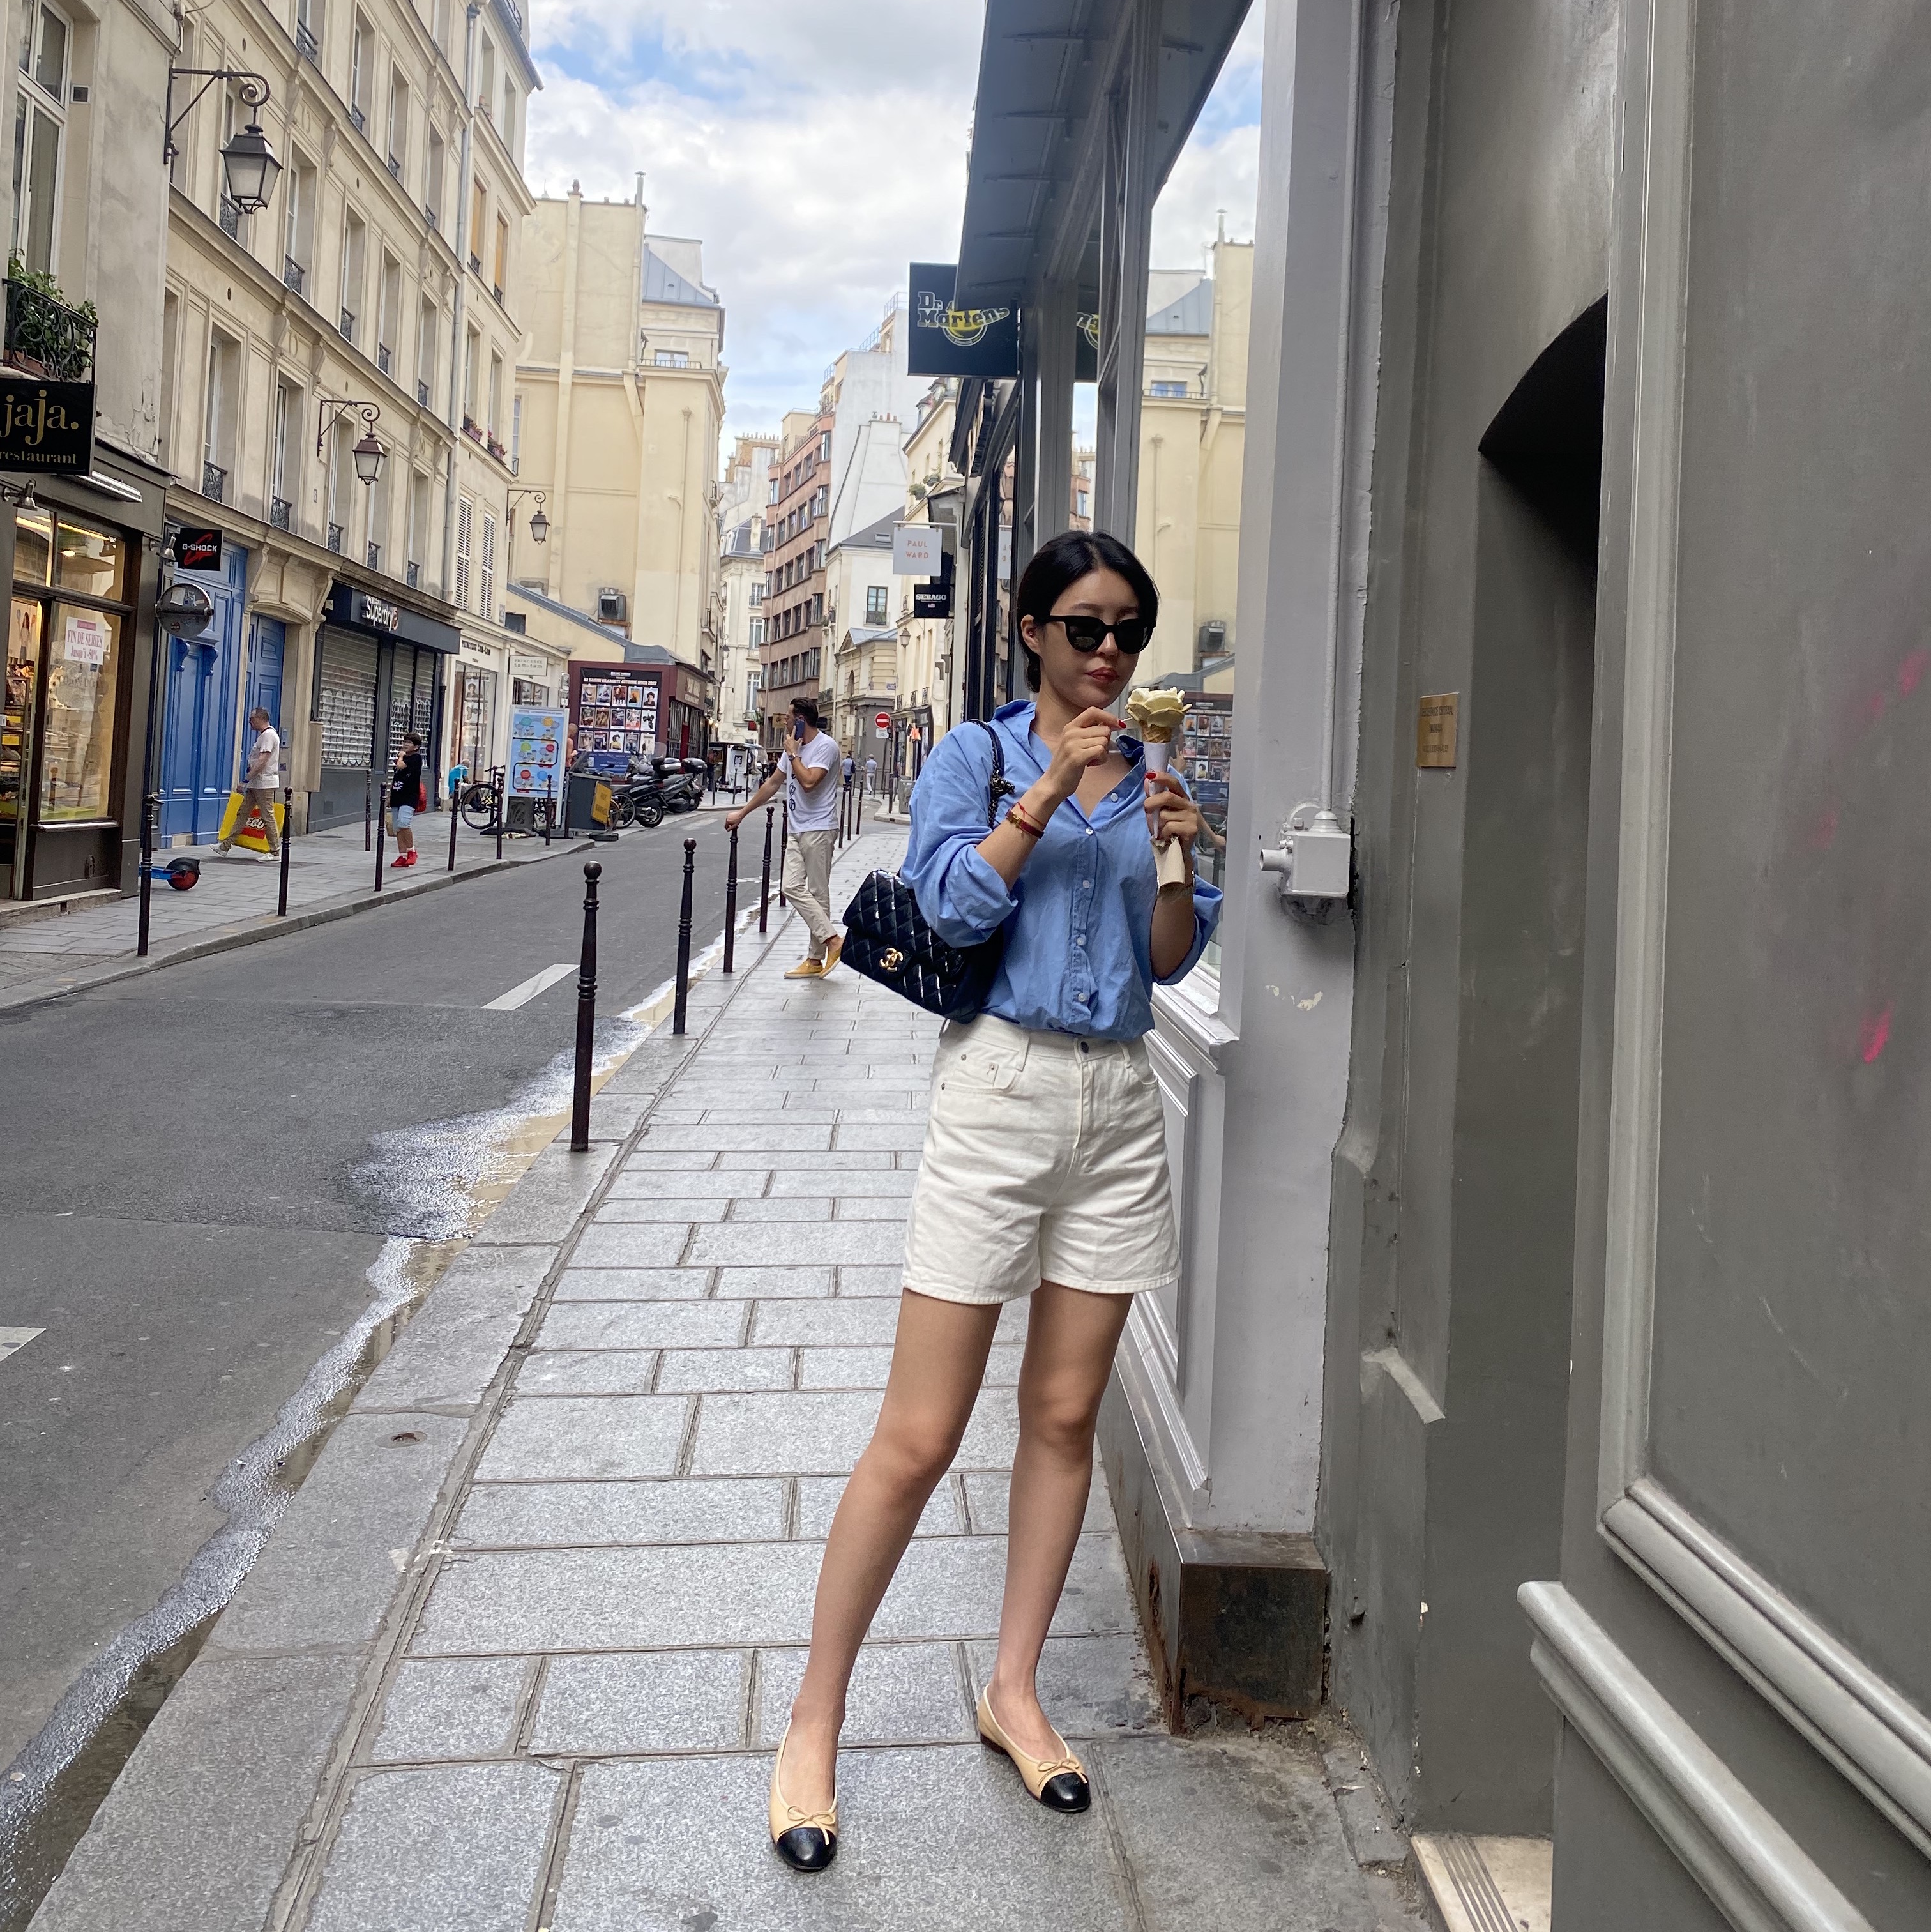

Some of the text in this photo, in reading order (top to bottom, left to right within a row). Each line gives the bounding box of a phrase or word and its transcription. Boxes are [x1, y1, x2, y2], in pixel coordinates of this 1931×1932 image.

[918, 291, 943, 310] Dr.
[917, 307, 1010, 328] Martens
[0, 389, 79, 445] jaja.
[0, 451, 77, 464] restaurant
[182, 544, 217, 552] G-SHOCK
[67, 630, 103, 648] FIN DE SERIES
[245, 817, 266, 829] EGO
